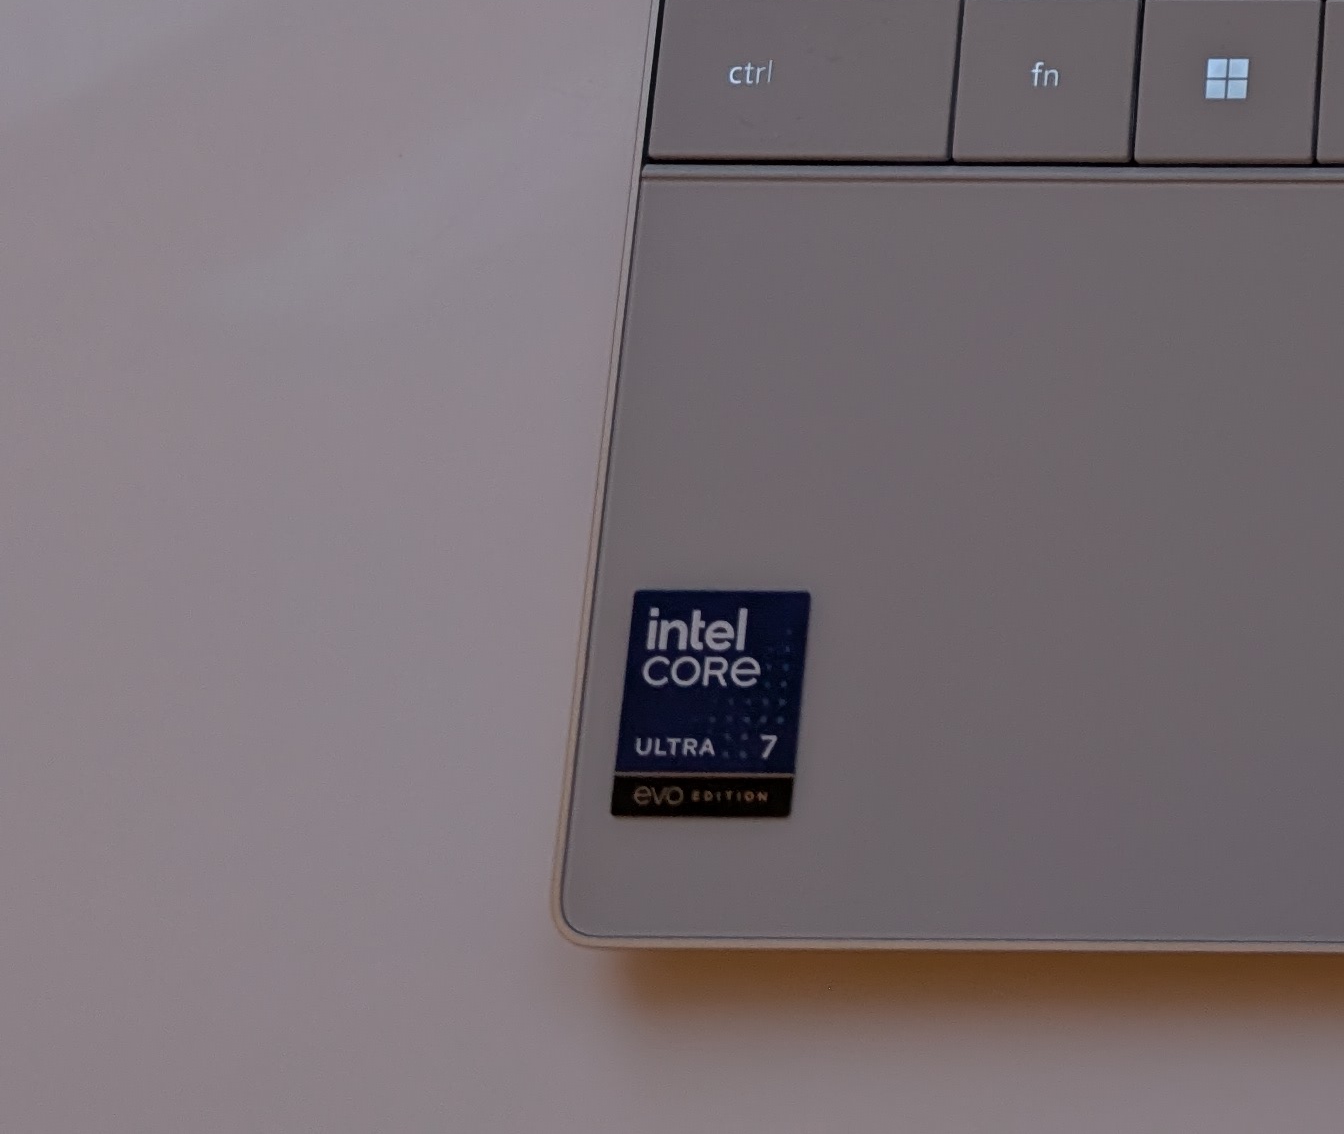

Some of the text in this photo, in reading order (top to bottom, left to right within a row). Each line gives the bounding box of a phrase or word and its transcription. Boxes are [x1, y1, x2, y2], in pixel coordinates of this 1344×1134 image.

[729, 59, 773, 85] ctrl
[1031, 61, 1059, 87] fn
[645, 607, 749, 652] intel
[635, 734, 778, 760] ULTRA 7
[691, 790, 769, 803] EDITION
